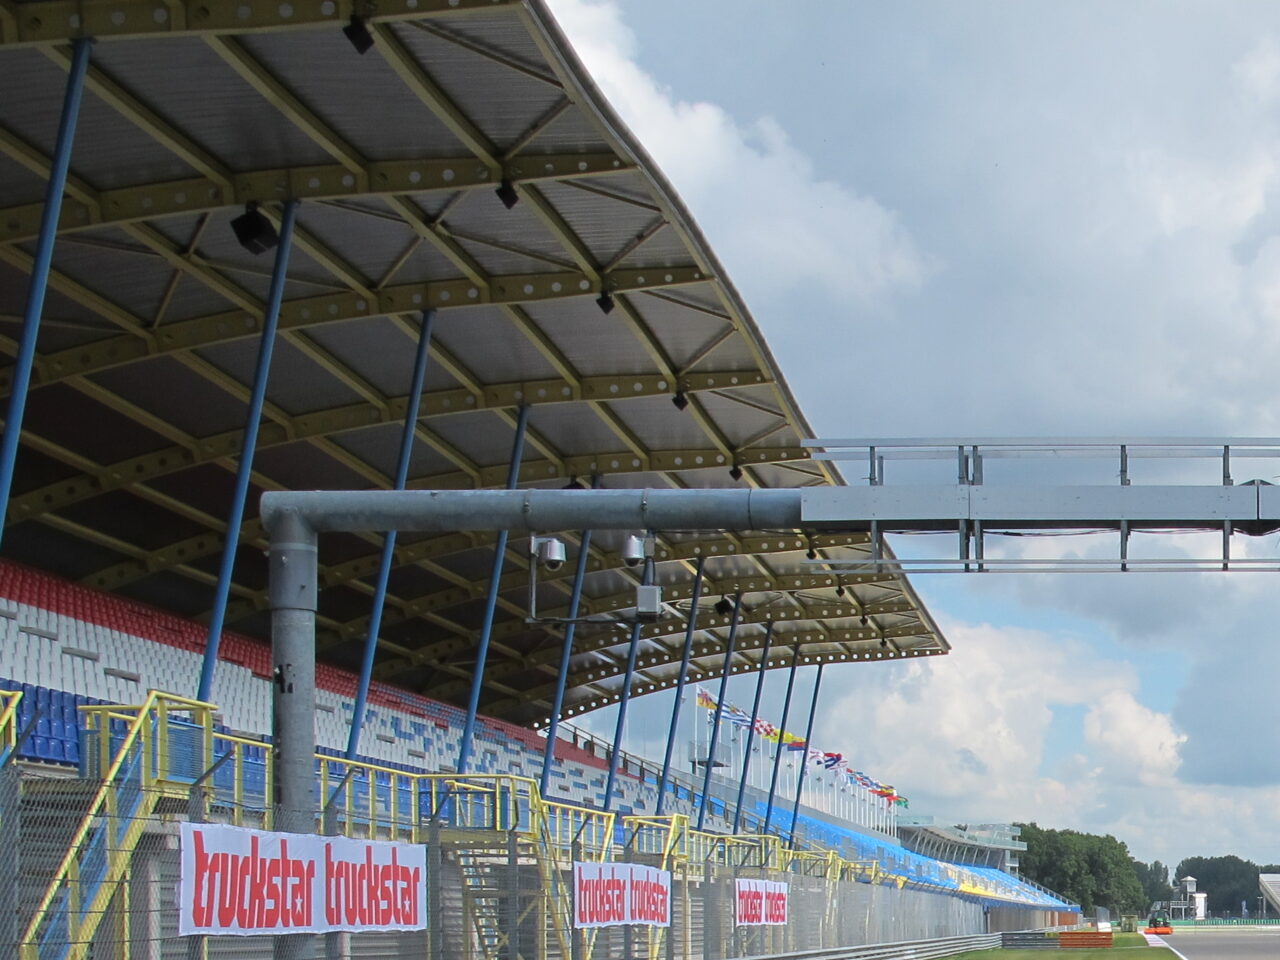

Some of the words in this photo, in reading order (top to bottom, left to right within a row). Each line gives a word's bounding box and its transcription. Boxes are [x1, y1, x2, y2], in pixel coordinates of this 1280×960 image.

[193, 831, 315, 928] truckstar
[325, 842, 420, 926] truckstar
[578, 867, 626, 923] truckstar
[630, 867, 668, 923] truckstar
